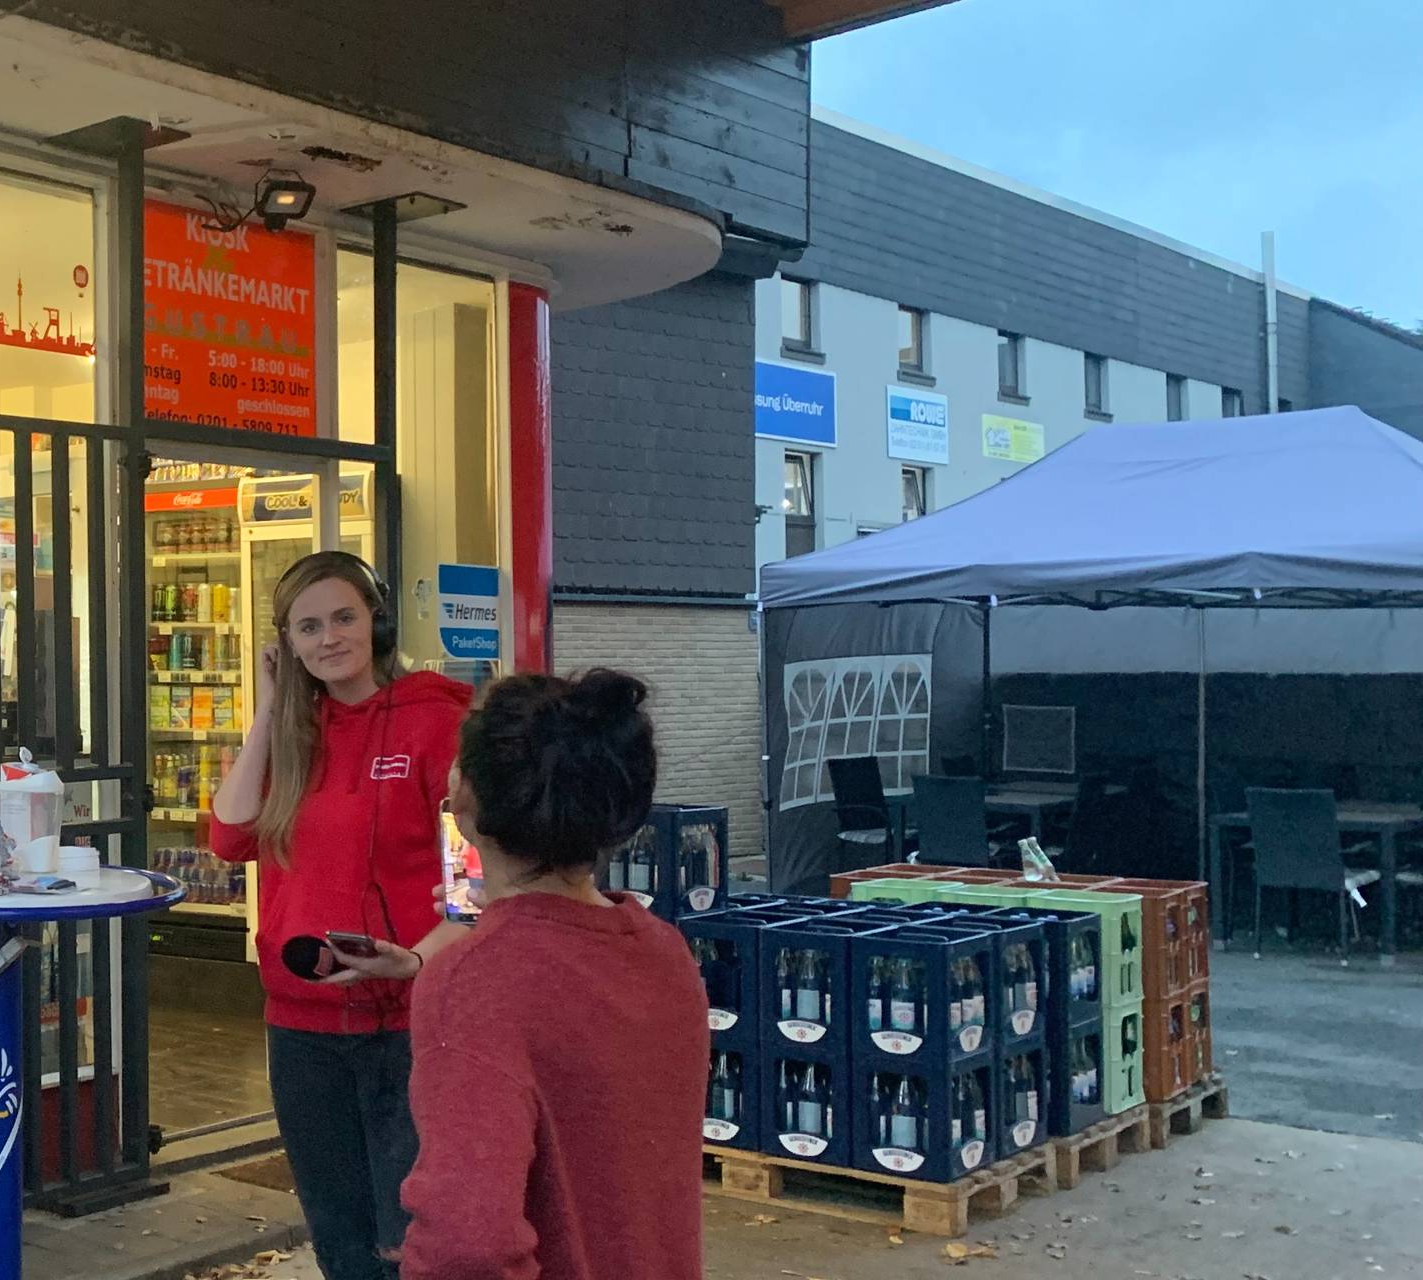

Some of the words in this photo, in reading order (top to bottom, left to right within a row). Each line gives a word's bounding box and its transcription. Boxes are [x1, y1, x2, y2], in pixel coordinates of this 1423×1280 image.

[161, 343, 178, 359] Fr.
[209, 350, 237, 368] 5:00
[250, 357, 285, 376] 18:00
[289, 363, 310, 379] Uhr
[209, 372, 237, 389] 8:00
[251, 377, 285, 395] 13:30
[289, 381, 310, 397] Uhr
[145, 407, 192, 423] elefon:
[237, 399, 310, 418] geschlossen
[455, 603, 497, 621] Hermes
[452, 635, 497, 651] PaketShop
